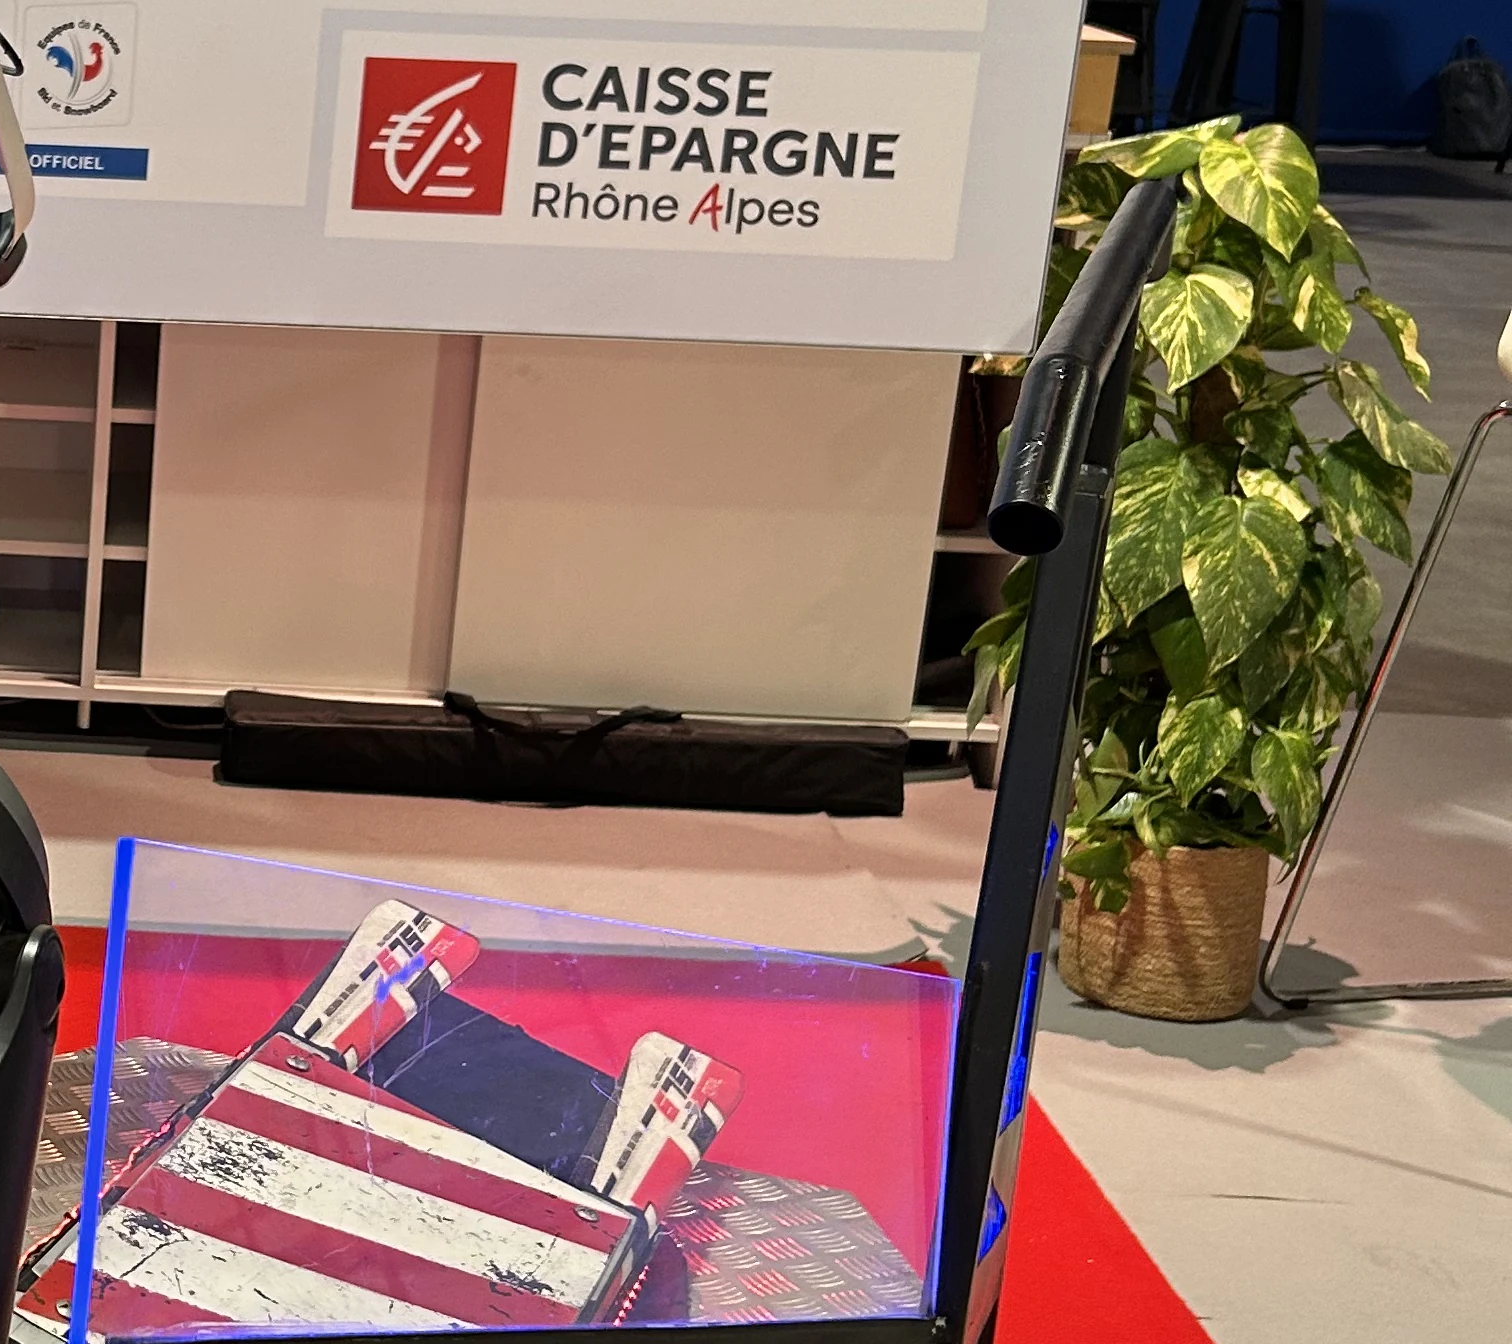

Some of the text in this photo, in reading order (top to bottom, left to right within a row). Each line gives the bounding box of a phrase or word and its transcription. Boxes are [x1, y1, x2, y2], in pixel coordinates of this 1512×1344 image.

[92, 23, 121, 55] France
[542, 63, 773, 117] CAISSE
[29, 154, 105, 171] OFFICIEL
[538, 121, 900, 180] D'EPARGNE
[532, 182, 820, 235] Rhône Alpes
